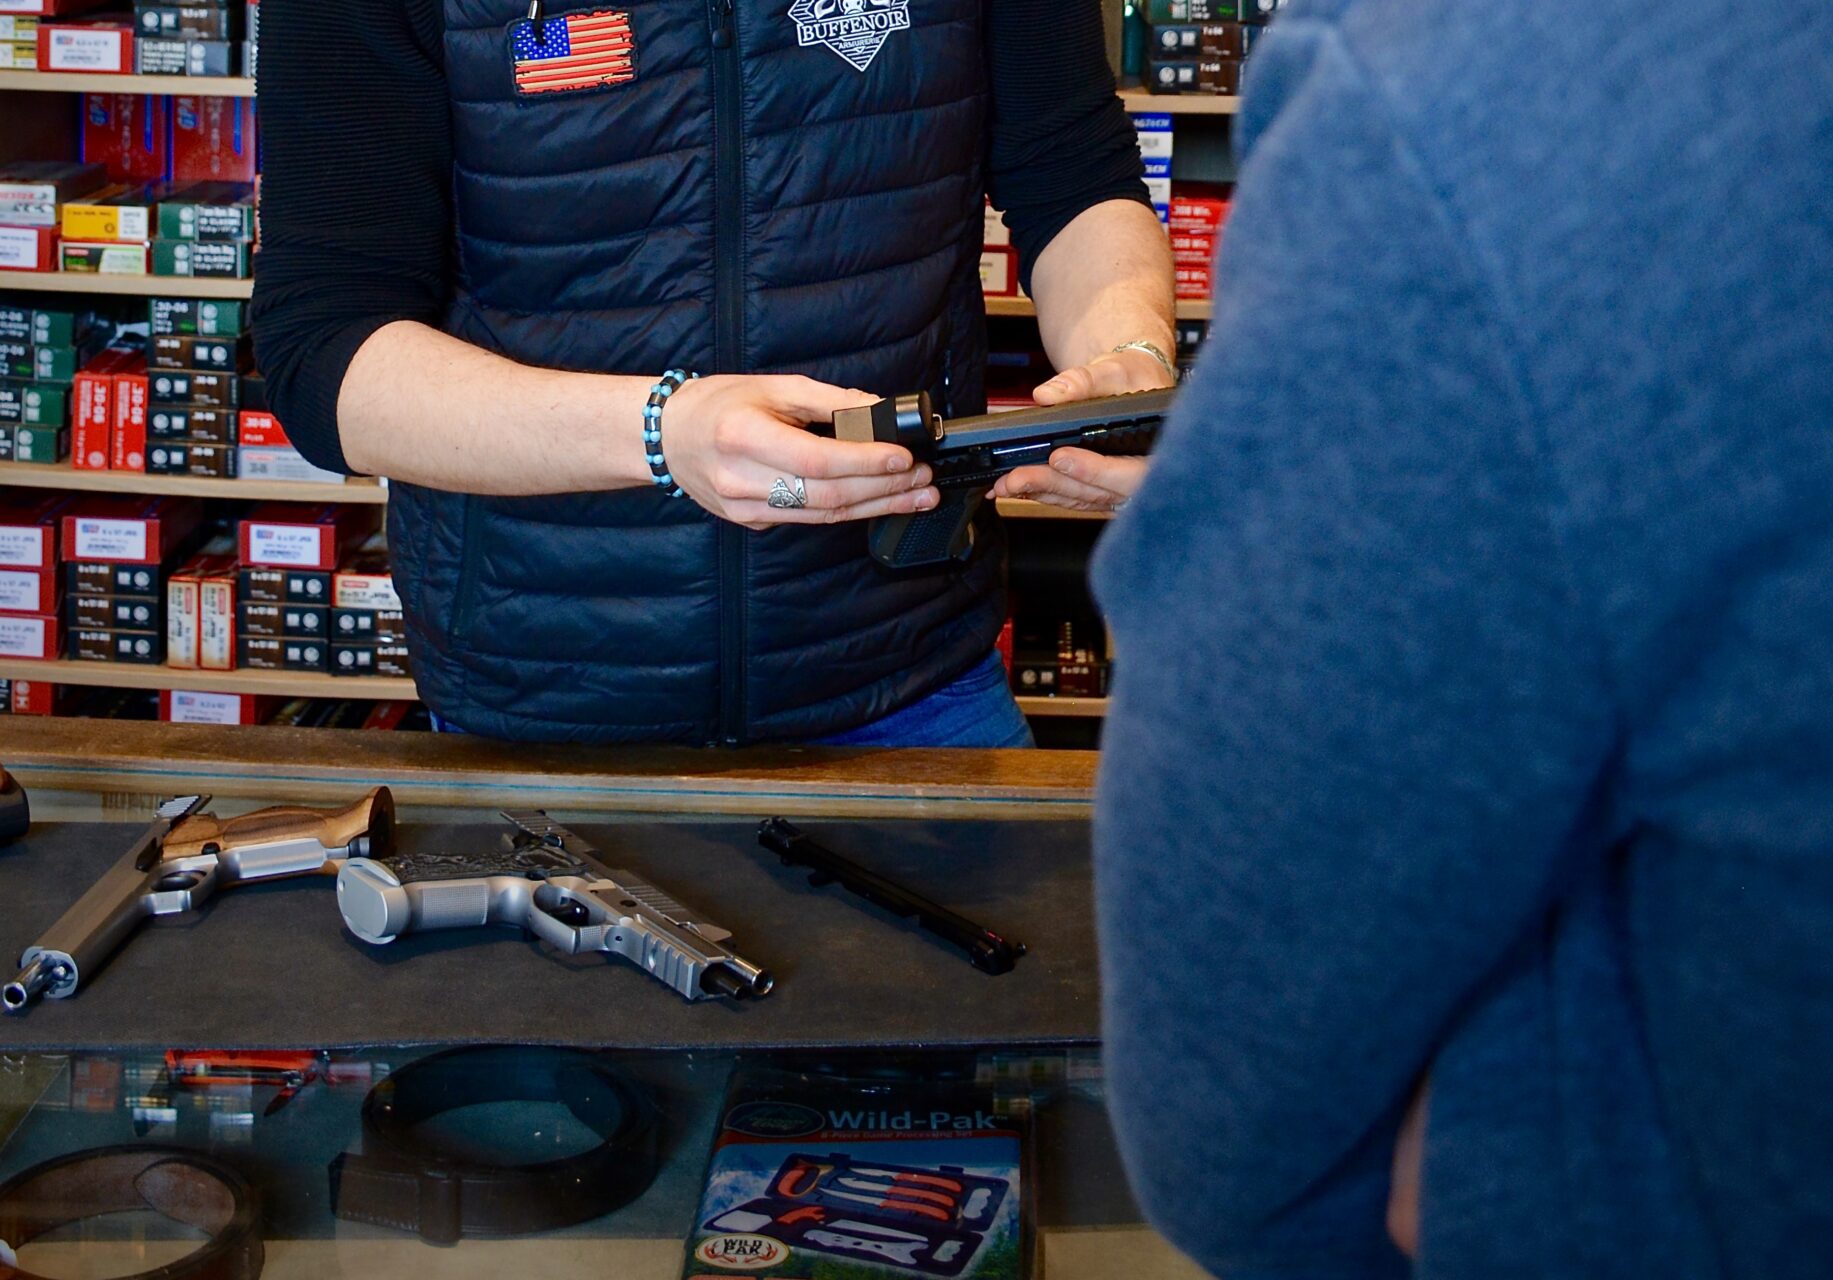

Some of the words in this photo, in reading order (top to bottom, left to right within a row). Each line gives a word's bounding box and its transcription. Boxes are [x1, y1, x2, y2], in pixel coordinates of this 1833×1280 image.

[801, 10, 908, 42] BUFFENOIR
[838, 36, 881, 50] ARMURERIE
[1601, 416, 1637, 439] W
[827, 1110, 998, 1131] Wild-Pak
[723, 1238, 763, 1247] WILD
[723, 1246, 761, 1255] PAK
